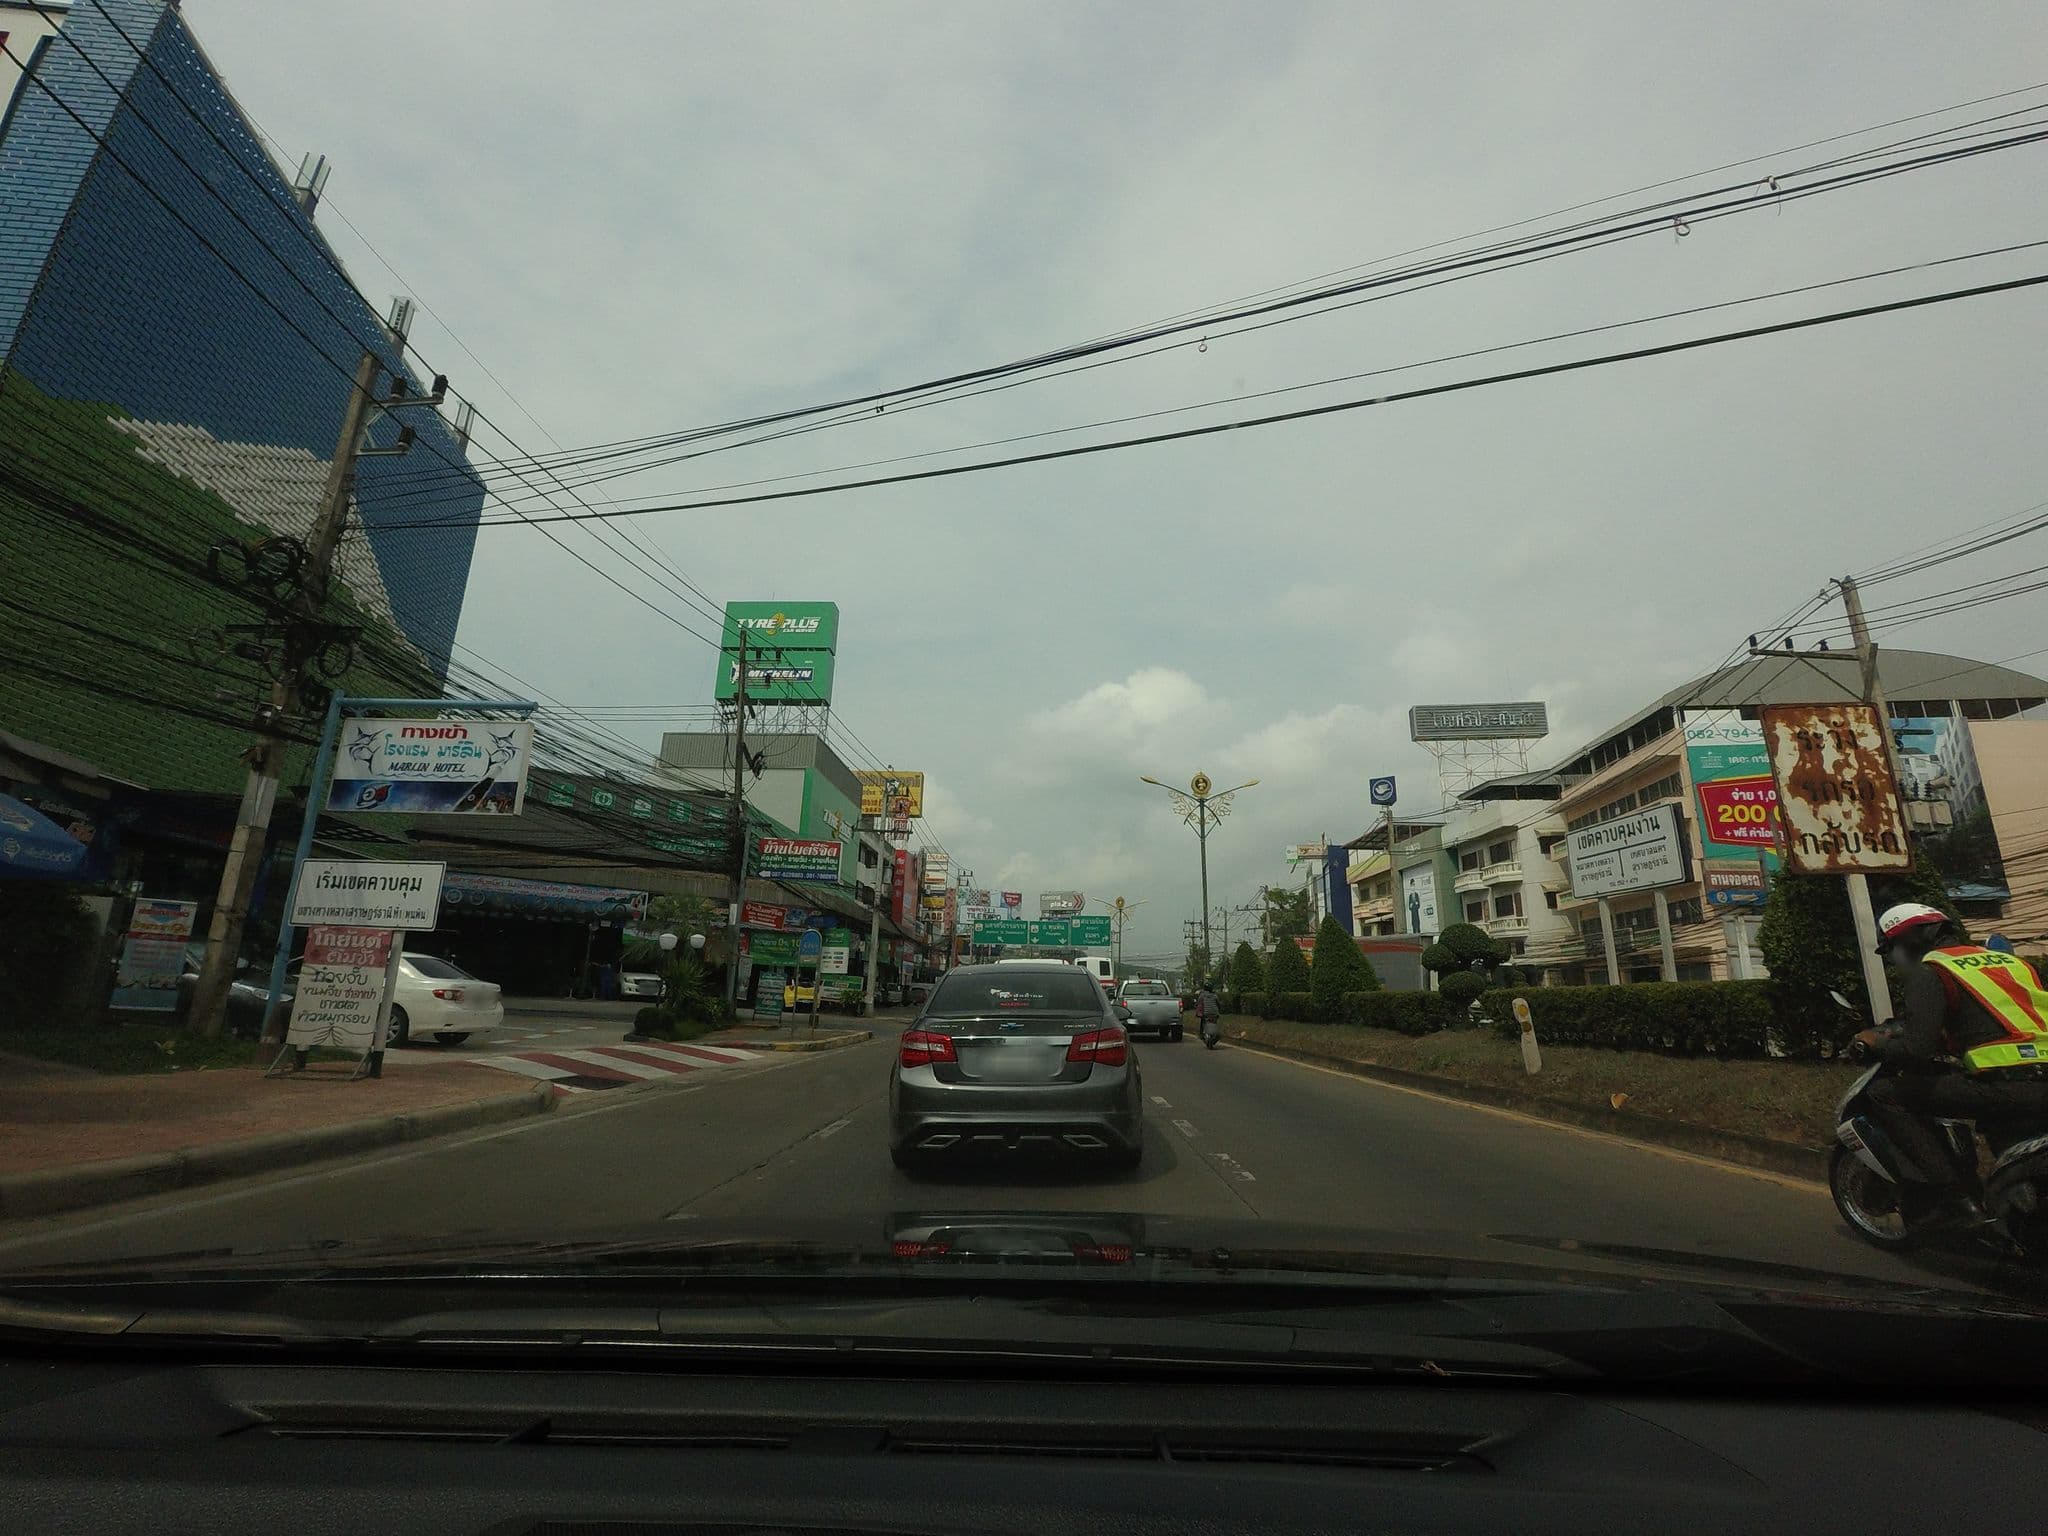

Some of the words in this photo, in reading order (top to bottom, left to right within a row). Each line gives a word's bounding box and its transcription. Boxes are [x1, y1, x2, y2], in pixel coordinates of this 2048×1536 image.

[737, 618, 777, 629] TYRE
[782, 618, 821, 629] PLUS
[748, 669, 812, 678] MICHELIN
[401, 724, 468, 740] ทางเข้า
[384, 734, 430, 756] โรงแรม
[388, 761, 430, 772] MARLIN
[432, 762, 466, 773] HOTEL
[1731, 787, 1754, 801] จ่าย
[1717, 804, 1767, 823] 200
[1577, 815, 1661, 850] เขตควบคุมงาน
[1733, 827, 1748, 838] ฟรี
[1800, 821, 1900, 855] กลับรถ
[763, 841, 838, 857] บ้านไมตรีจิต
[316, 866, 422, 899] เริ่มเขตควบคุม
[1710, 874, 1761, 887] ลานจอดรถ
[1951, 953, 2016, 970] POLICE
